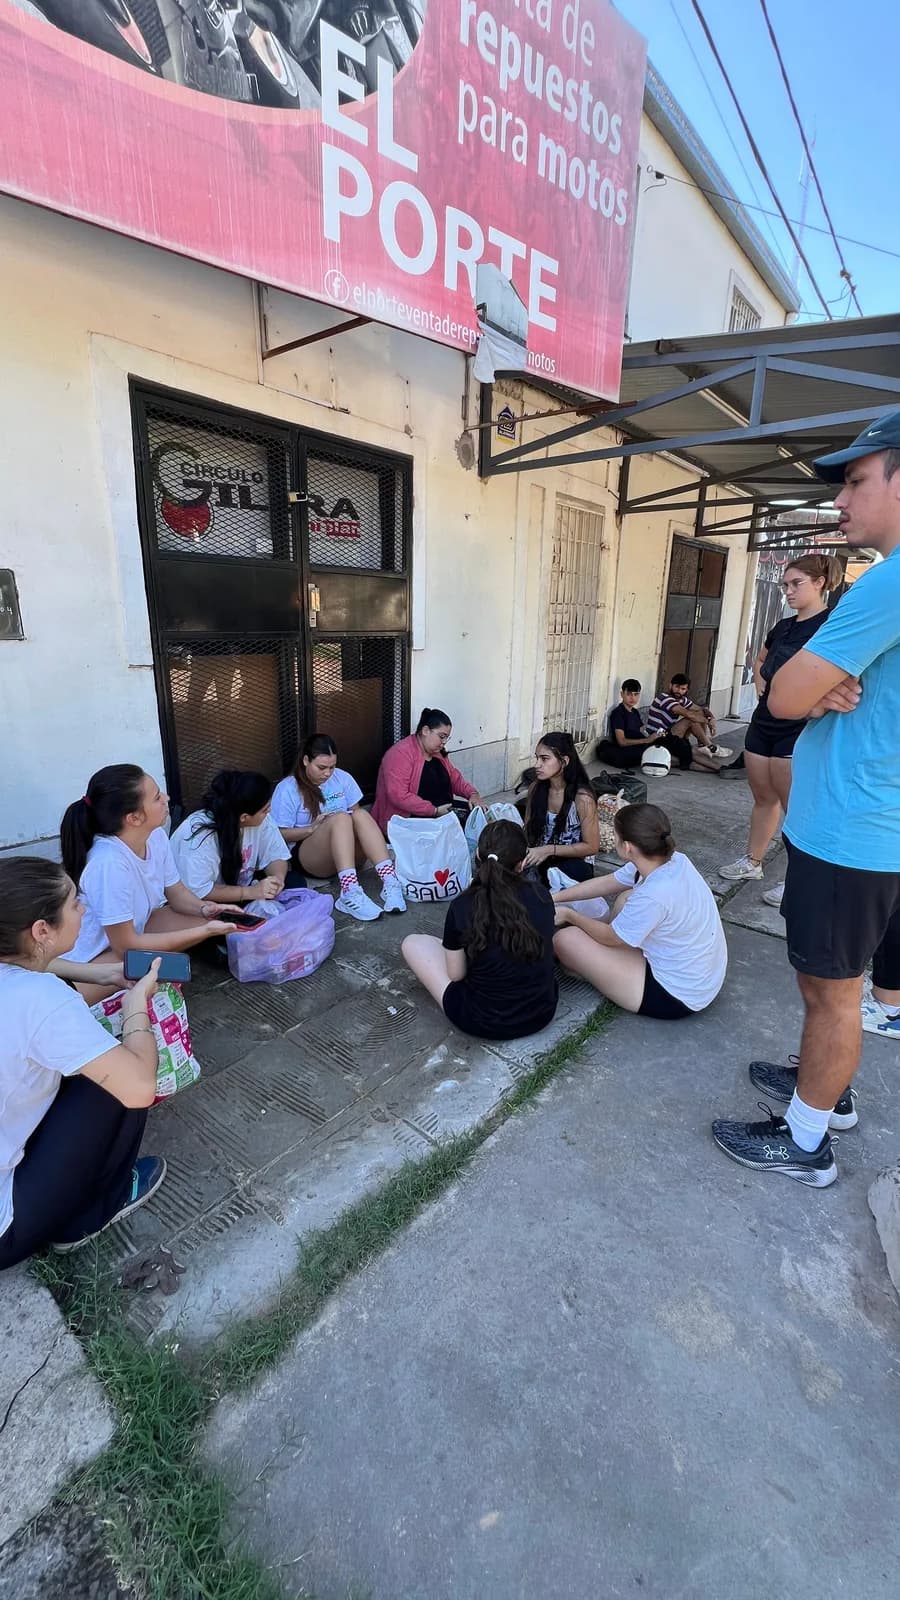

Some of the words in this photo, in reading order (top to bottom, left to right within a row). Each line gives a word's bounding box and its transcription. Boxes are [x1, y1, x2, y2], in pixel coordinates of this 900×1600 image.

[320, 18, 418, 172] EL
[460, 0, 622, 154] repuestos
[562, 0, 595, 66] de
[458, 79, 528, 166] para
[538, 132, 628, 225] motos
[322, 142, 559, 332] PORTE
